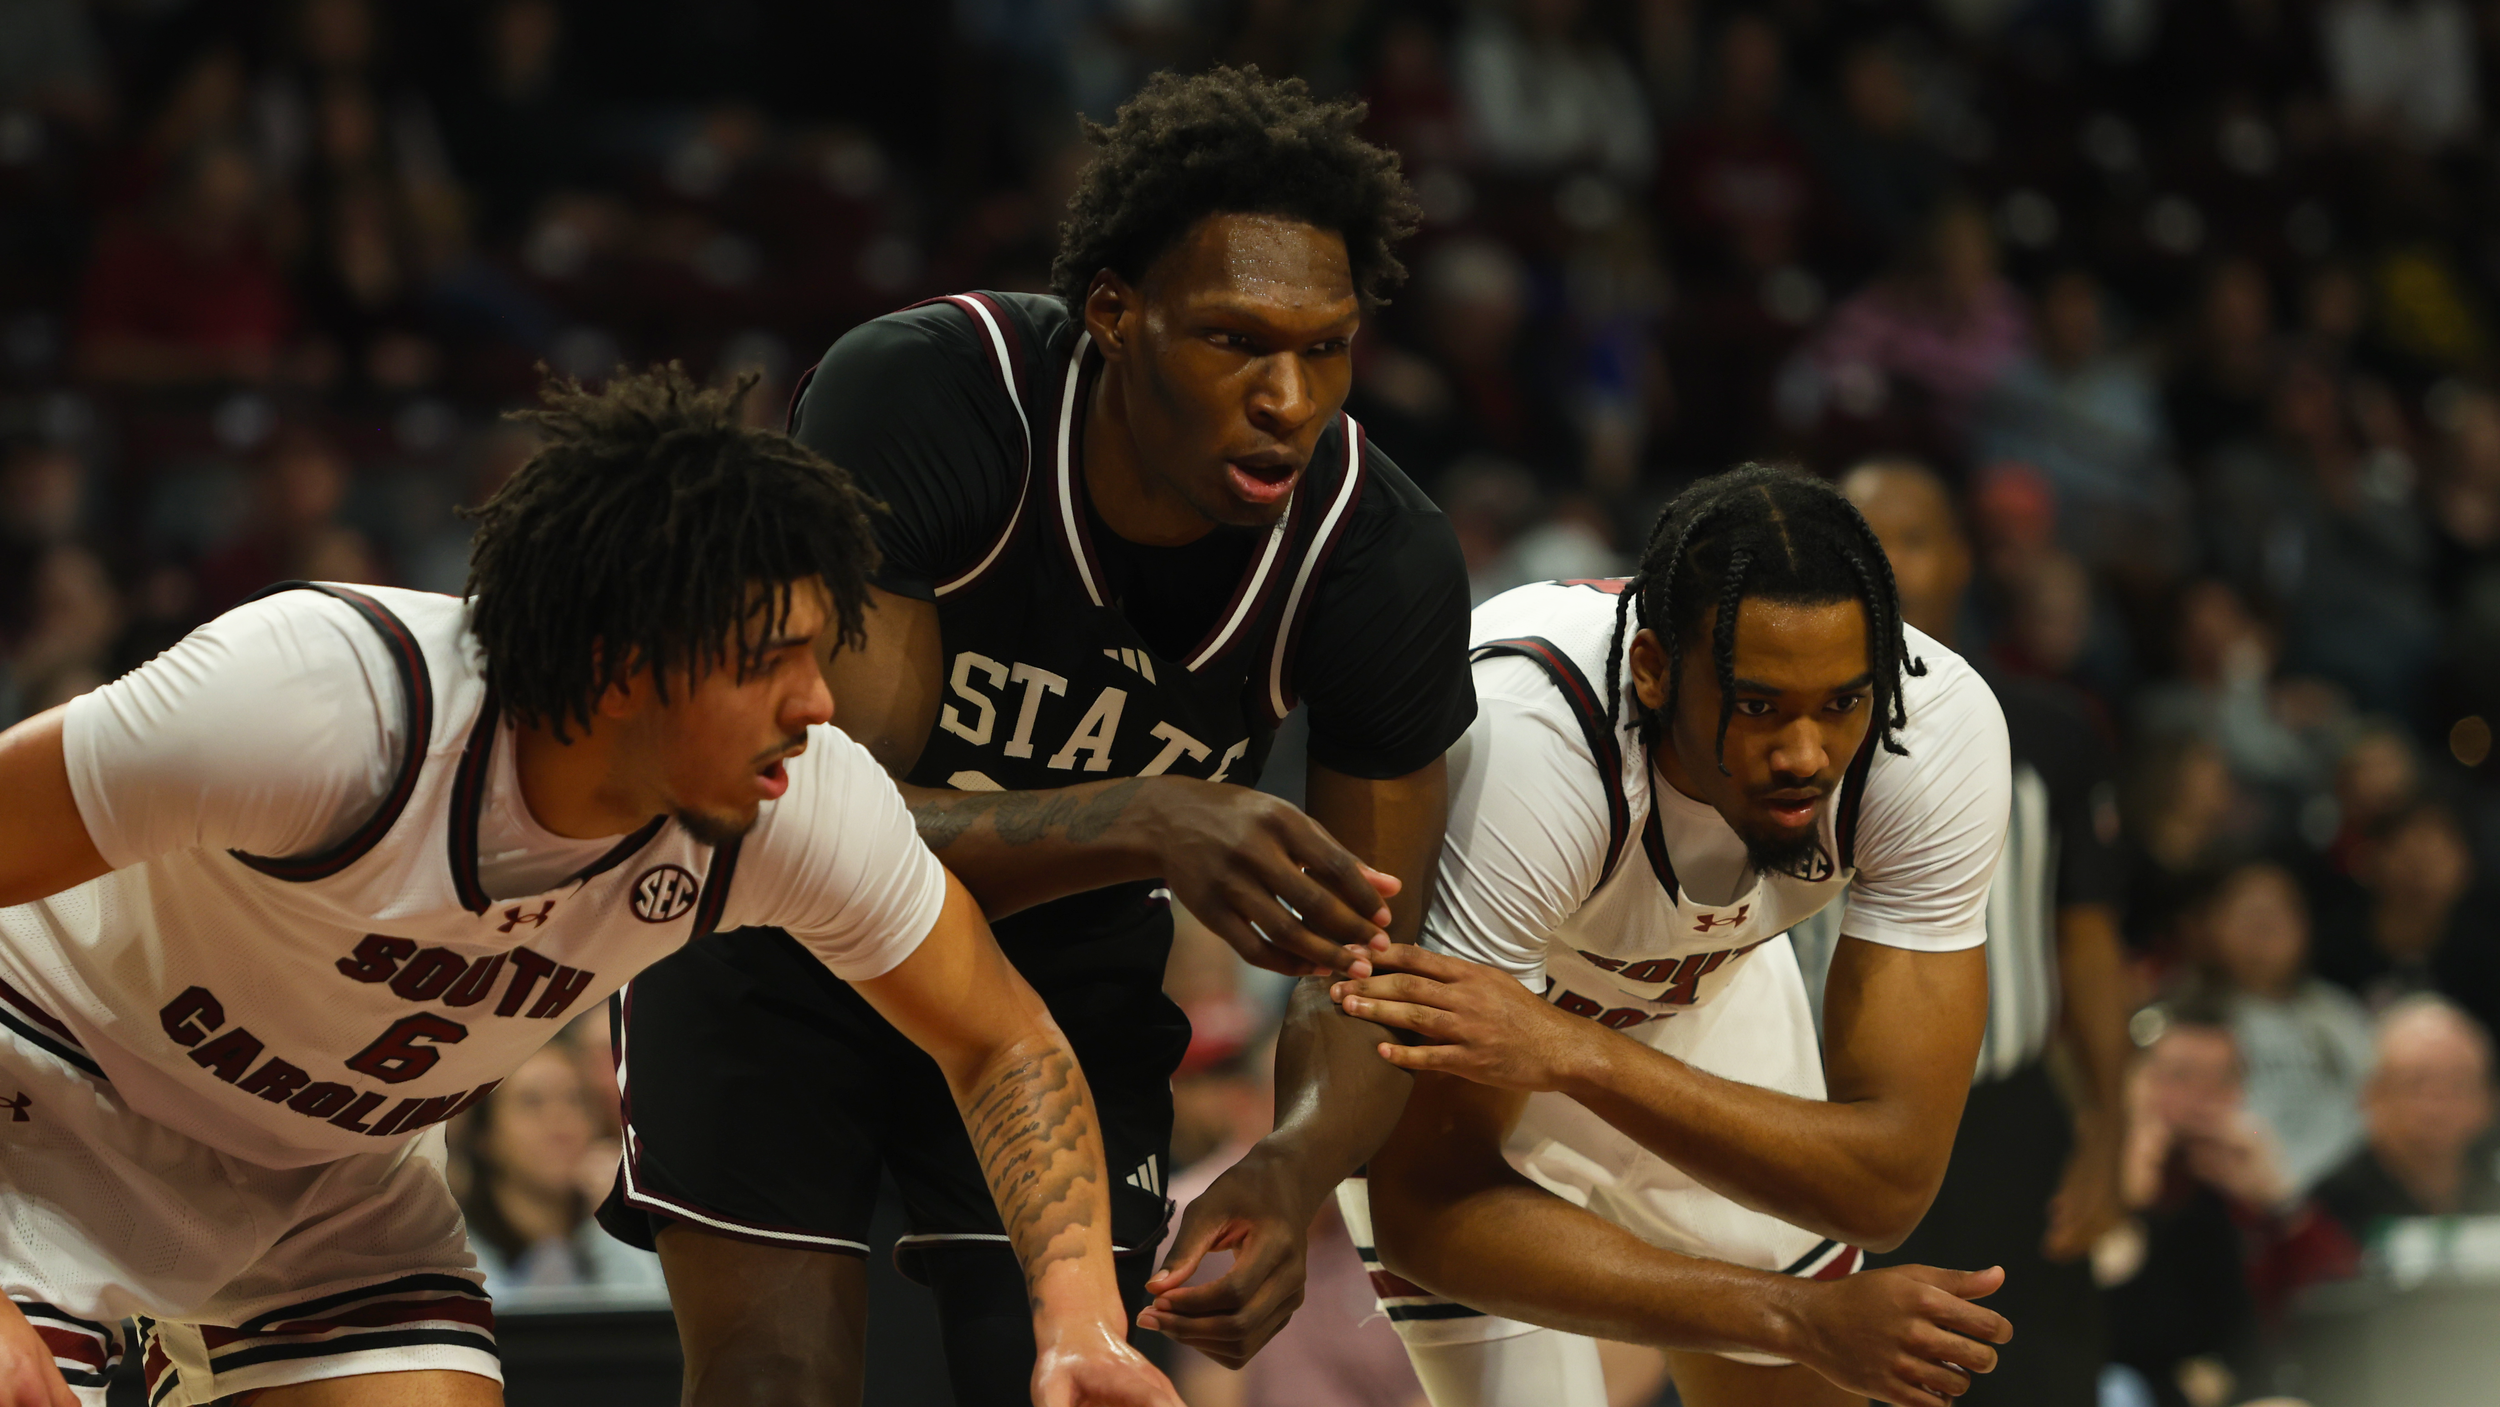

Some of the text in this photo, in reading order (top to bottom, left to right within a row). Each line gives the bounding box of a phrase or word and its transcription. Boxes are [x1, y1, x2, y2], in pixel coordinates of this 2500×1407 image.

[634, 868, 695, 920] SEC
[335, 934, 596, 1019] SOUTH
[344, 1012, 469, 1084] 6
